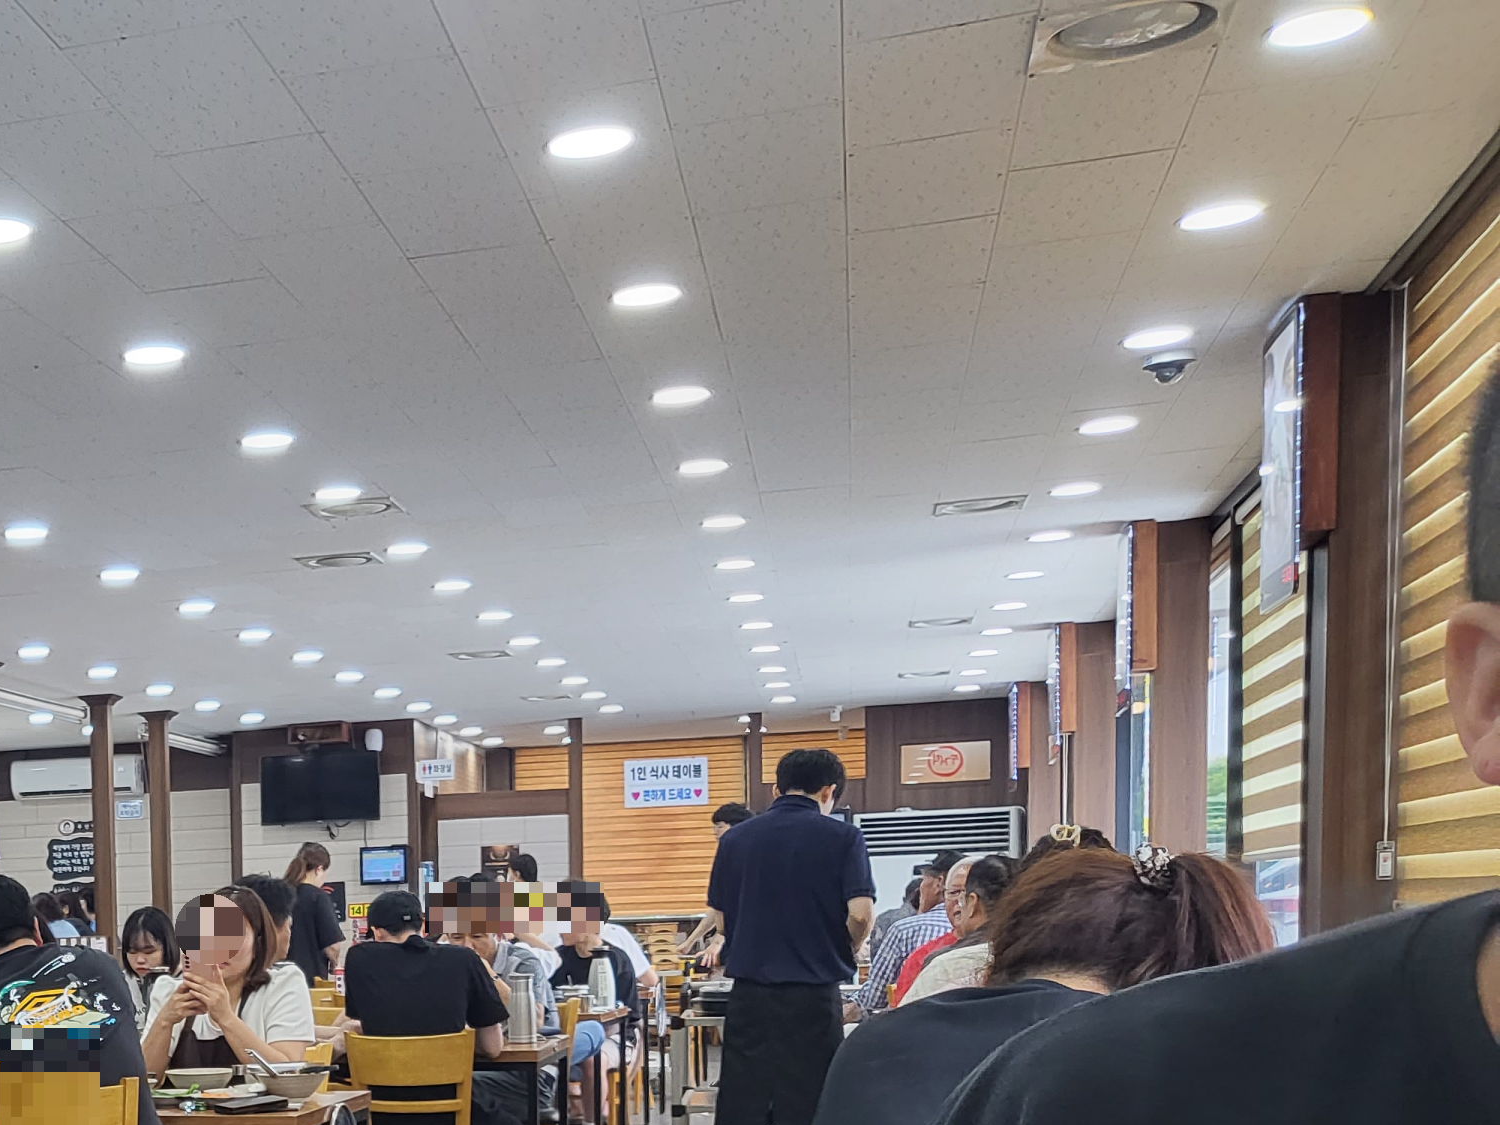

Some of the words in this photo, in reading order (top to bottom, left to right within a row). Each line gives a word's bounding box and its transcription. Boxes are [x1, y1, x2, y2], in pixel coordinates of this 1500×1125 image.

[433, 764, 452, 774] 화장실
[630, 766, 647, 781] 1인
[649, 765, 670, 780] 식사
[672, 764, 702, 779] 테이블
[643, 789, 666, 802] 편하게
[668, 788, 692, 801] 드세요
[351, 905, 362, 916] 14
